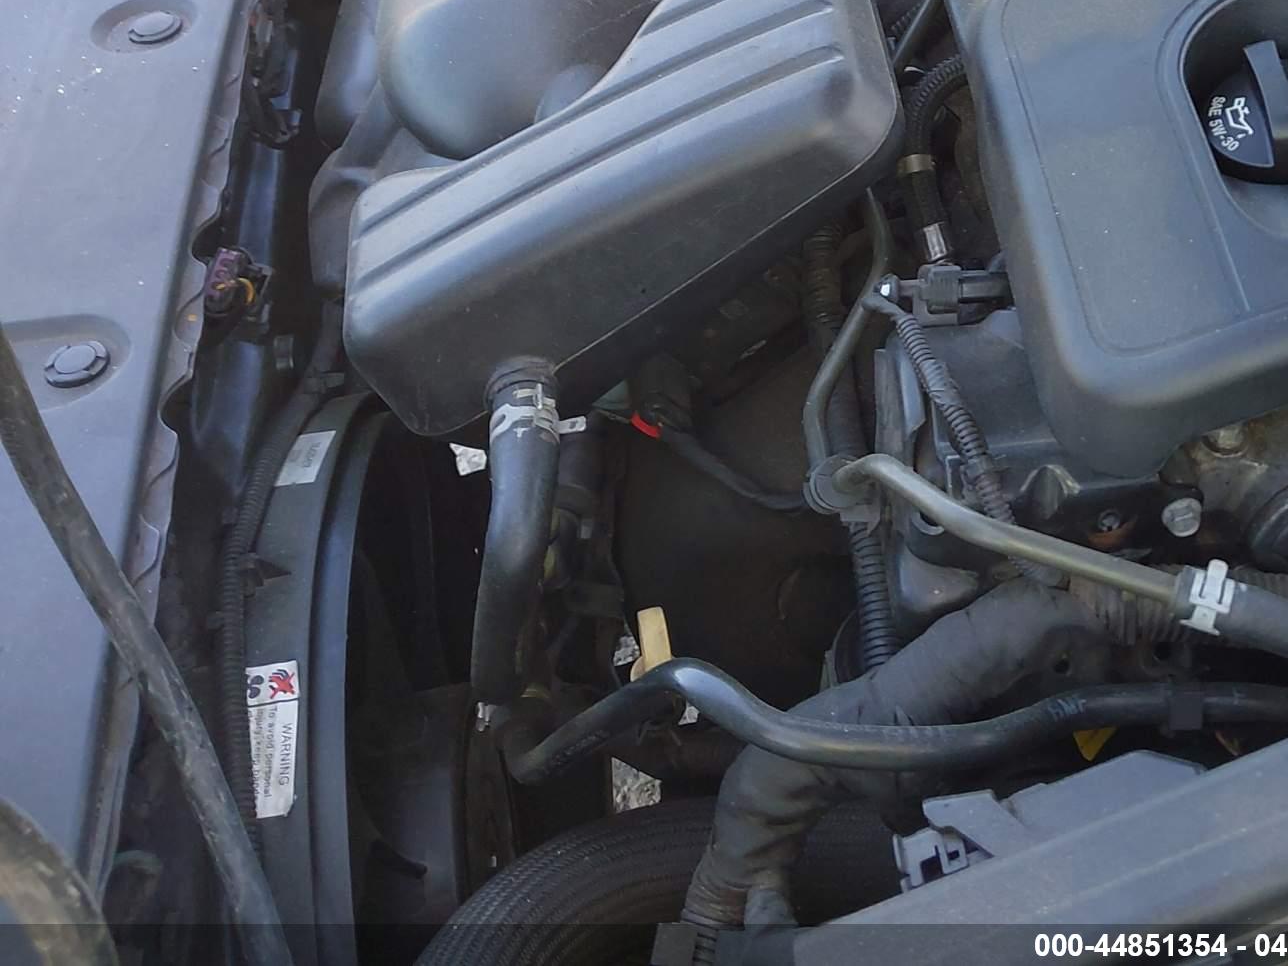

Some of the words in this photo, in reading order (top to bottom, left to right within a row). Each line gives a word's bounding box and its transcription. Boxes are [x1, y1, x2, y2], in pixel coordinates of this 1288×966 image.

[1208, 95, 1226, 117] SAE
[1208, 118, 1240, 152] 5W-30
[267, 705, 278, 719] To
[265, 722, 275, 749] avoid
[279, 722, 293, 786] WARNING
[263, 753, 273, 798] personal
